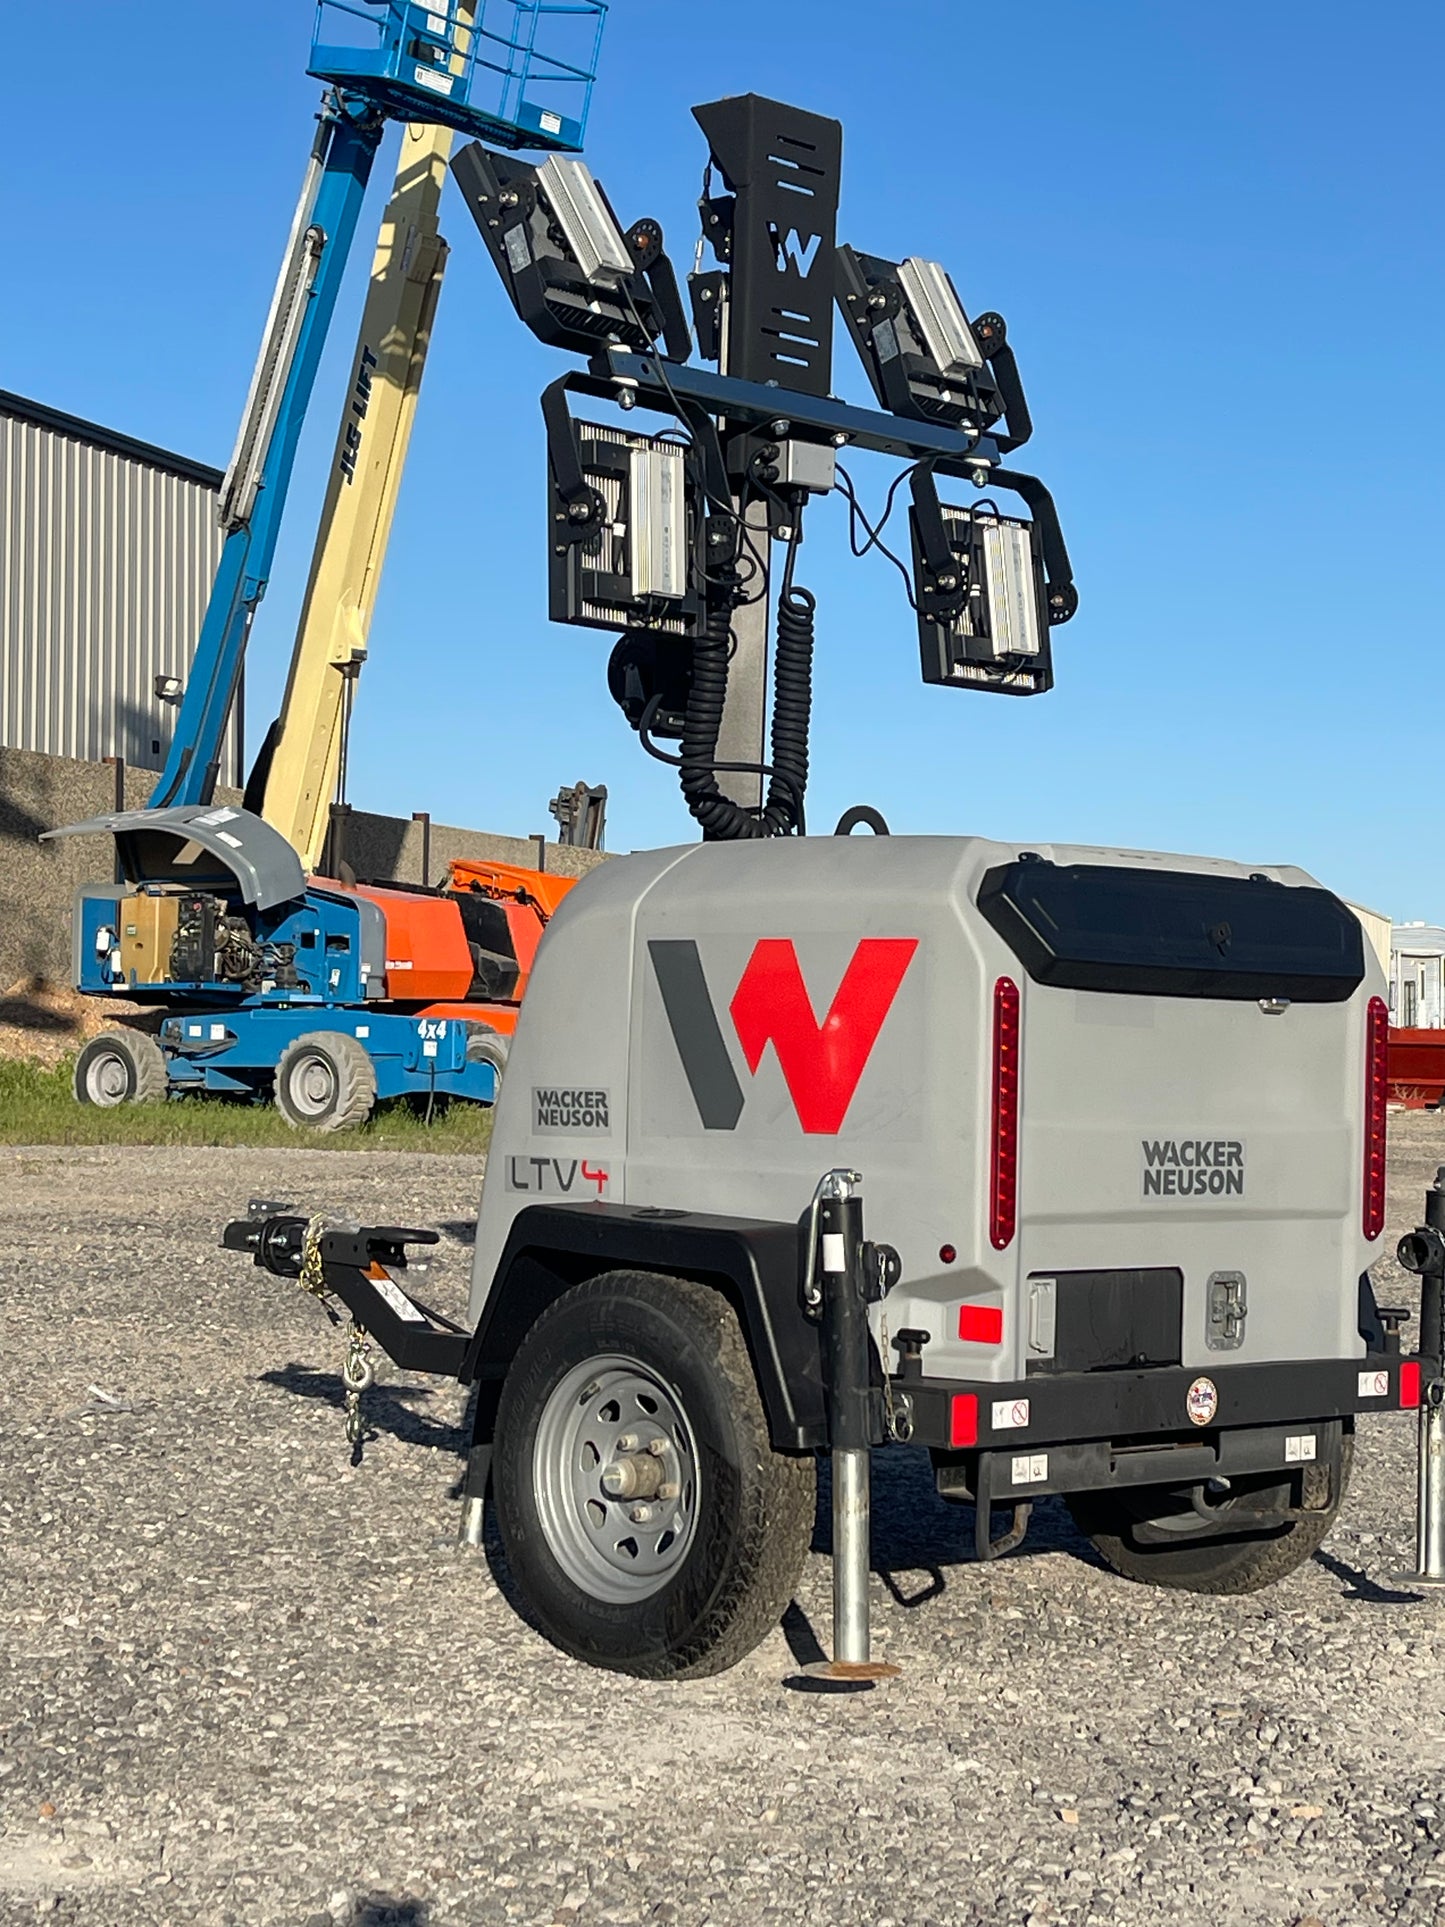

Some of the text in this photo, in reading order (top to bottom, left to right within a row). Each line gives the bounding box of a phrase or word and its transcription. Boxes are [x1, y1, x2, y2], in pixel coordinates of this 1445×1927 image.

[339, 344, 378, 486] JLG LIFT
[417, 1018, 447, 1040] 4x4
[537, 1090, 608, 1109] WACKER
[538, 1109, 609, 1128] NEUSON
[1142, 1140, 1244, 1167] WACKER
[511, 1156, 609, 1194] LTV4
[1143, 1169, 1244, 1196] NEUSON
